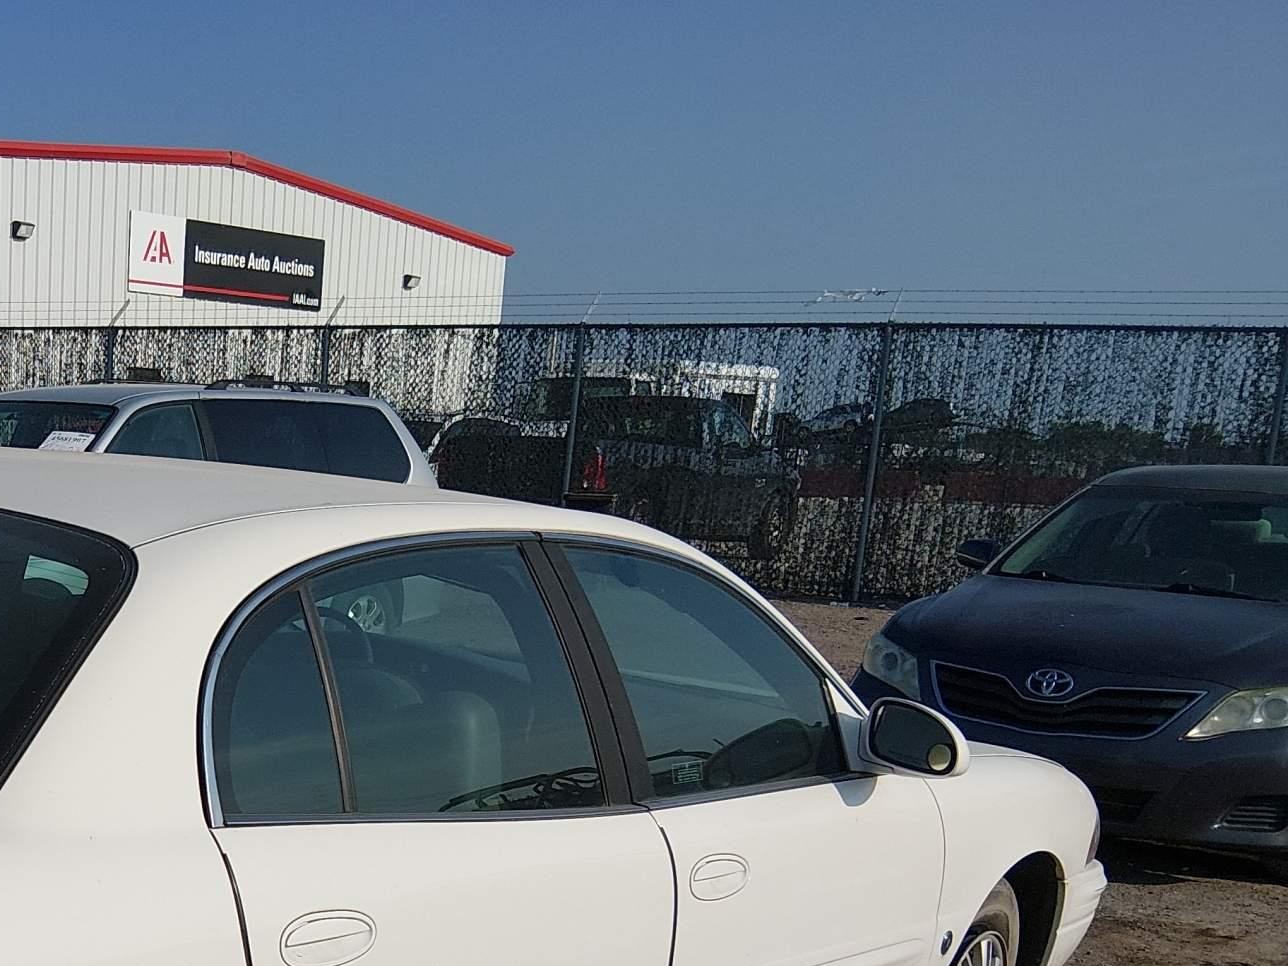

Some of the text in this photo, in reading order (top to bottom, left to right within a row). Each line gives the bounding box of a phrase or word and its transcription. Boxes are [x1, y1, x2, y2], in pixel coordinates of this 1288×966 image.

[194, 245, 315, 277] Insurance Auto Auctions
